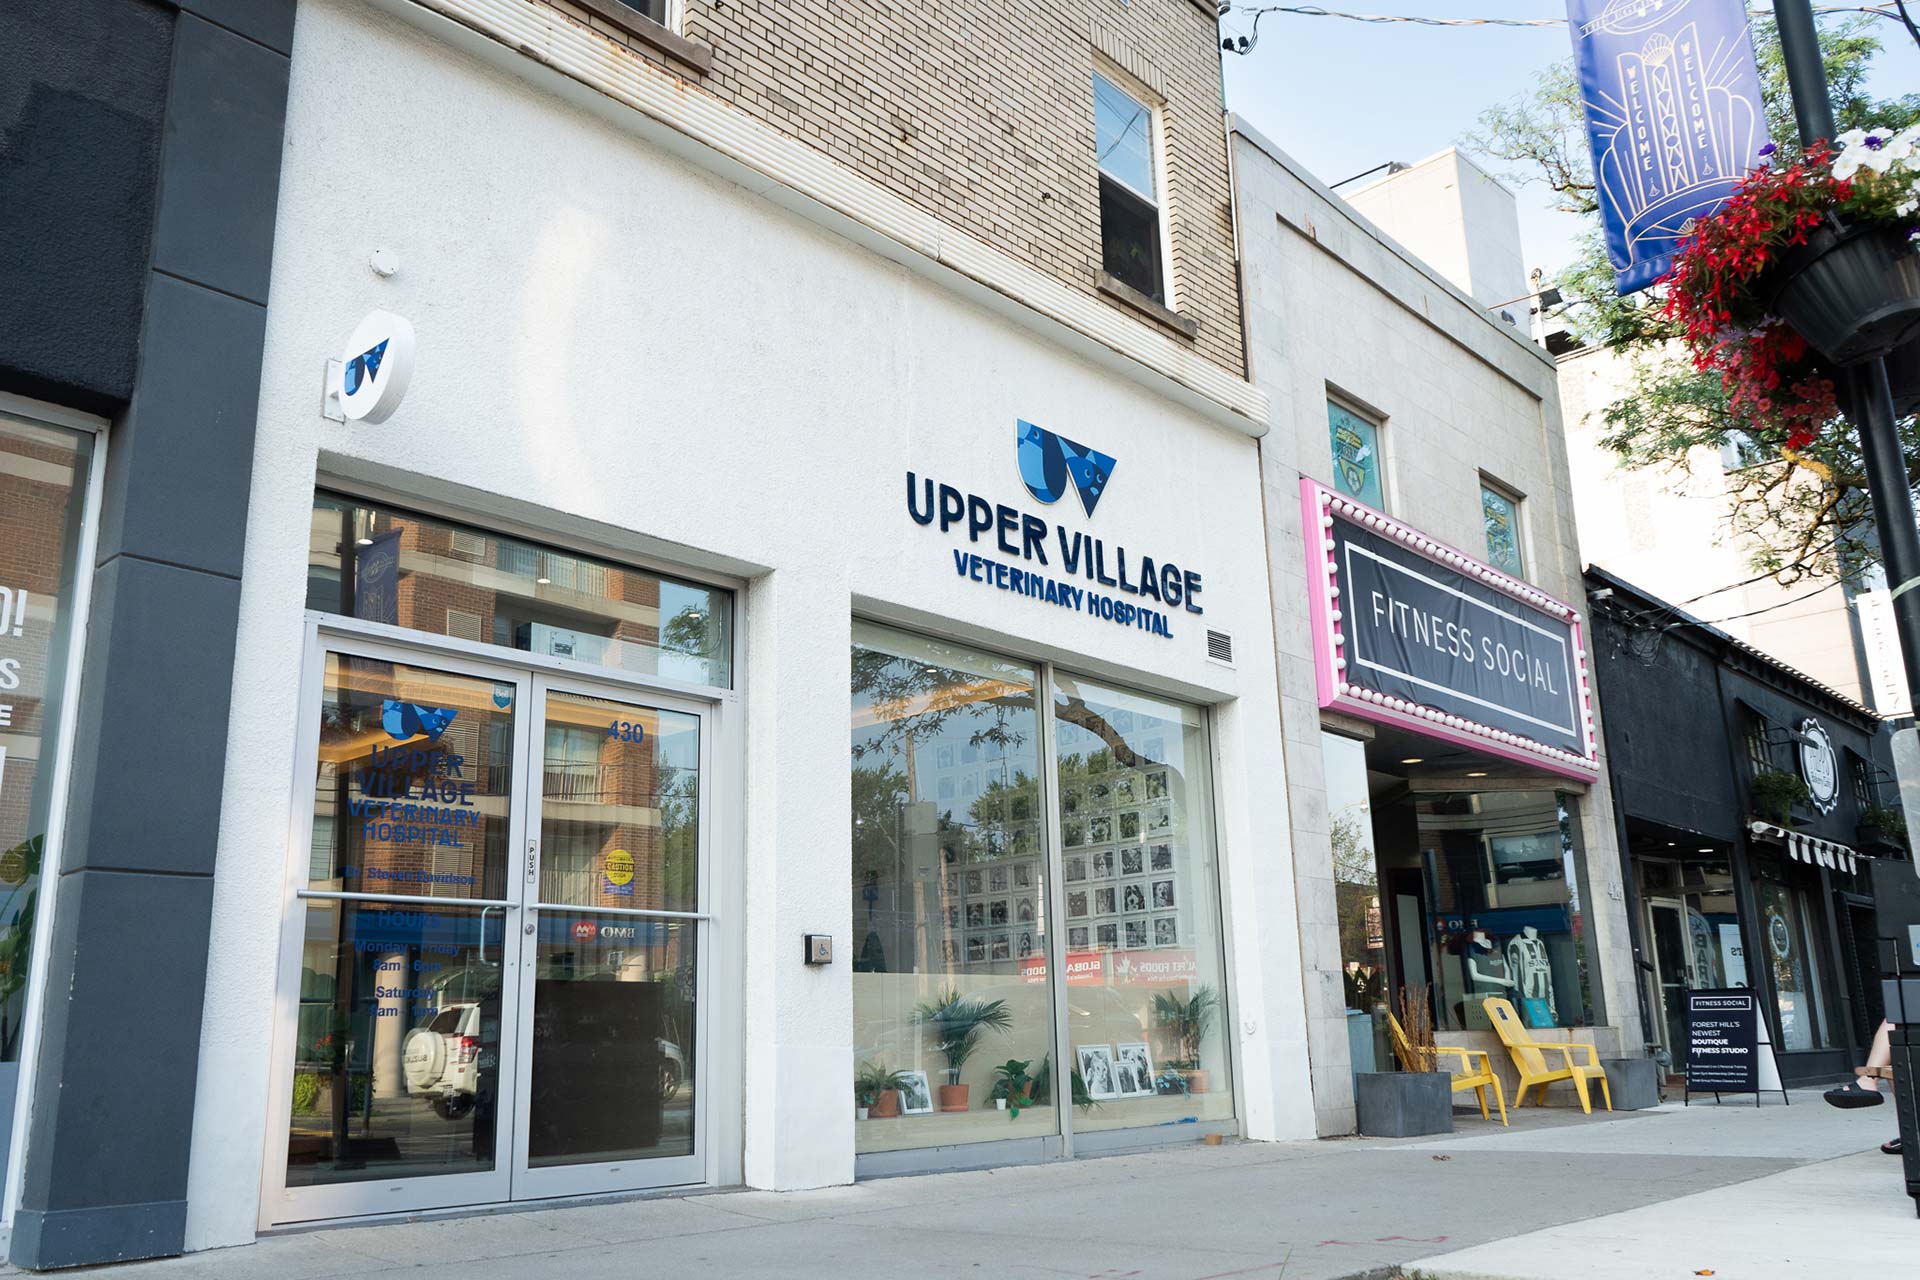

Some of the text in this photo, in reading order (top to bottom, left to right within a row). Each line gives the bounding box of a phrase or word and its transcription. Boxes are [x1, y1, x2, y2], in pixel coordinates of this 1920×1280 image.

[1680, 41, 1708, 149] WELCOME
[1626, 66, 1653, 171] WELCOME
[907, 471, 1204, 615] UPPER VILLAGE
[953, 549, 1174, 639] VETERINARY HOSPITAL
[1371, 590, 1559, 695] FITNESS SOCIAL
[607, 719, 644, 744] 430
[371, 743, 465, 778] UPPER
[355, 770, 475, 806] VILLAGE
[348, 797, 481, 828] VETERINARY
[361, 821, 465, 848] HOSPITAL
[607, 863, 633, 871] CAUTION
[378, 910, 441, 928] HOURS
[355, 938, 409, 955] Monday
[421, 942, 461, 957] Friday
[413, 960, 441, 974] 6pm
[375, 985, 435, 1001] Saturday
[1691, 1038, 1729, 1046] BOUTIQUE
